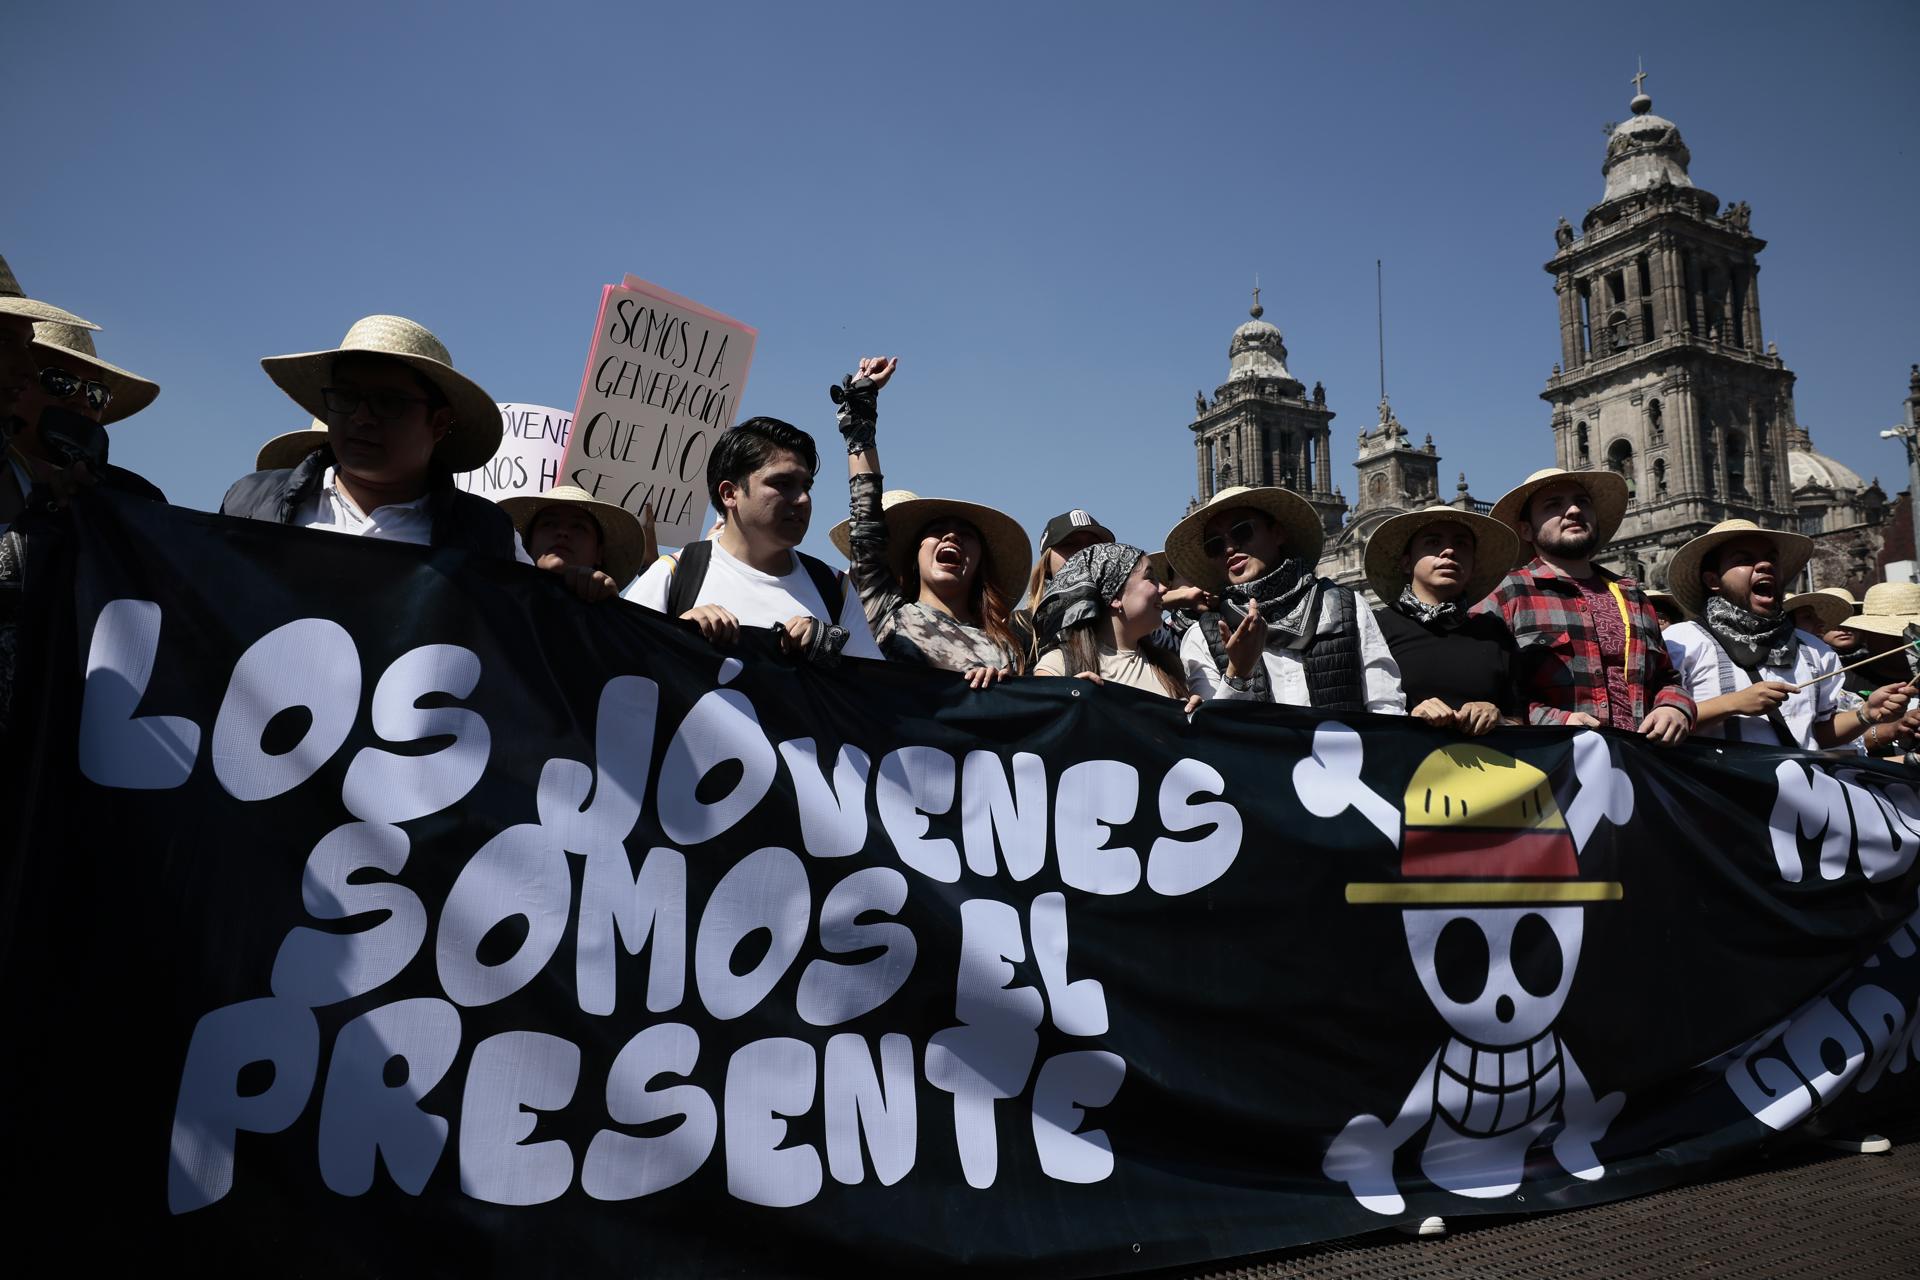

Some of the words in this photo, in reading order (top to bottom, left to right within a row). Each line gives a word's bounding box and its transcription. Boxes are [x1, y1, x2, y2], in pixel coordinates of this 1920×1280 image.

[609, 299, 690, 369] SOMOS
[693, 329, 729, 381] LA
[500, 404, 573, 448] ÓVENE
[595, 355, 736, 429] GENERACIÓN
[483, 456, 528, 492] NOS
[583, 411, 645, 463] QUE
[651, 423, 708, 484] NO
[620, 482, 693, 526] CALLA
[78, 599, 491, 824] LOS
[536, 658, 1243, 896] JÓVENES
[270, 821, 917, 1027] SOMOS
[955, 892, 1109, 1036] EL
[167, 997, 1126, 1215] PRESENTE
